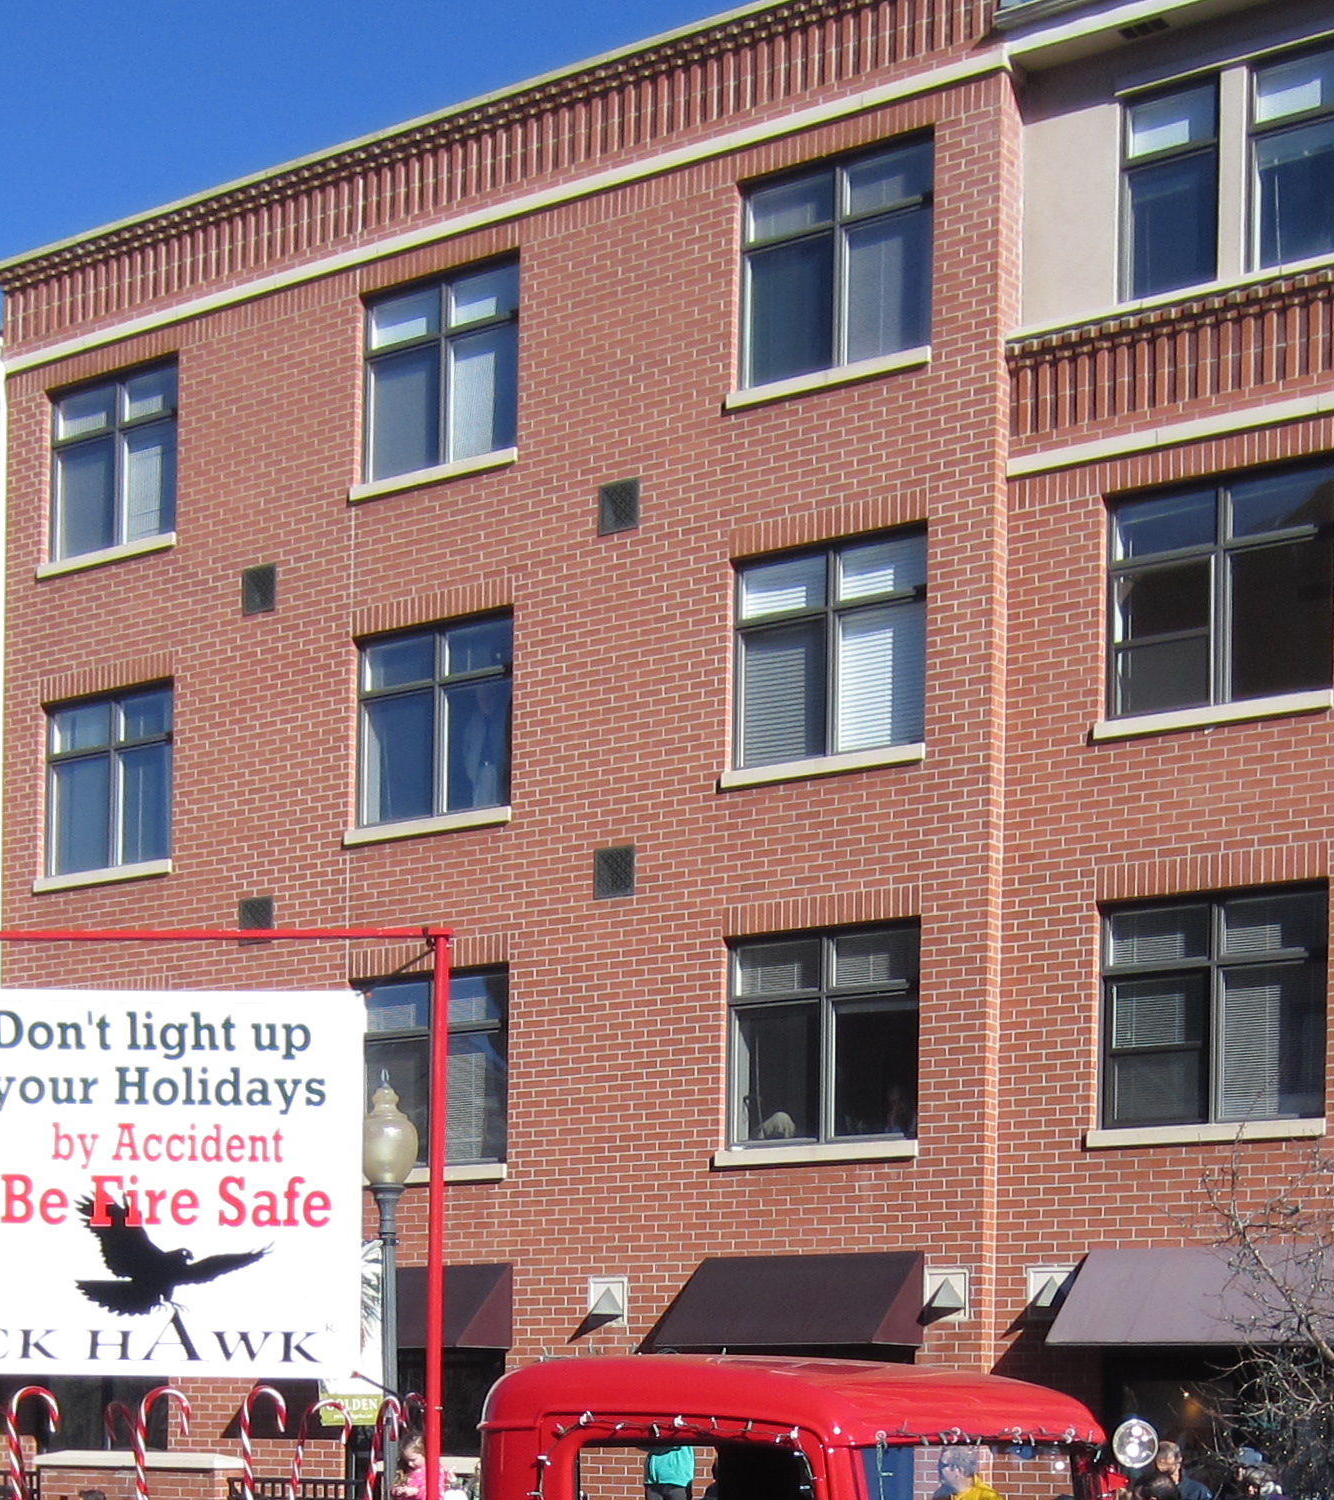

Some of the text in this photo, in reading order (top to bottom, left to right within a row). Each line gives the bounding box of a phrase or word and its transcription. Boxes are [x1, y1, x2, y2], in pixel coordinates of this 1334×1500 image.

[127, 1011, 235, 1058] light
[253, 1021, 311, 1059] up
[115, 1067, 326, 1114] Holidays
[52, 1123, 283, 1168] by Accident
[1, 1174, 331, 1227] Be Fire Safe
[88, 1311, 322, 1363] HAWK
